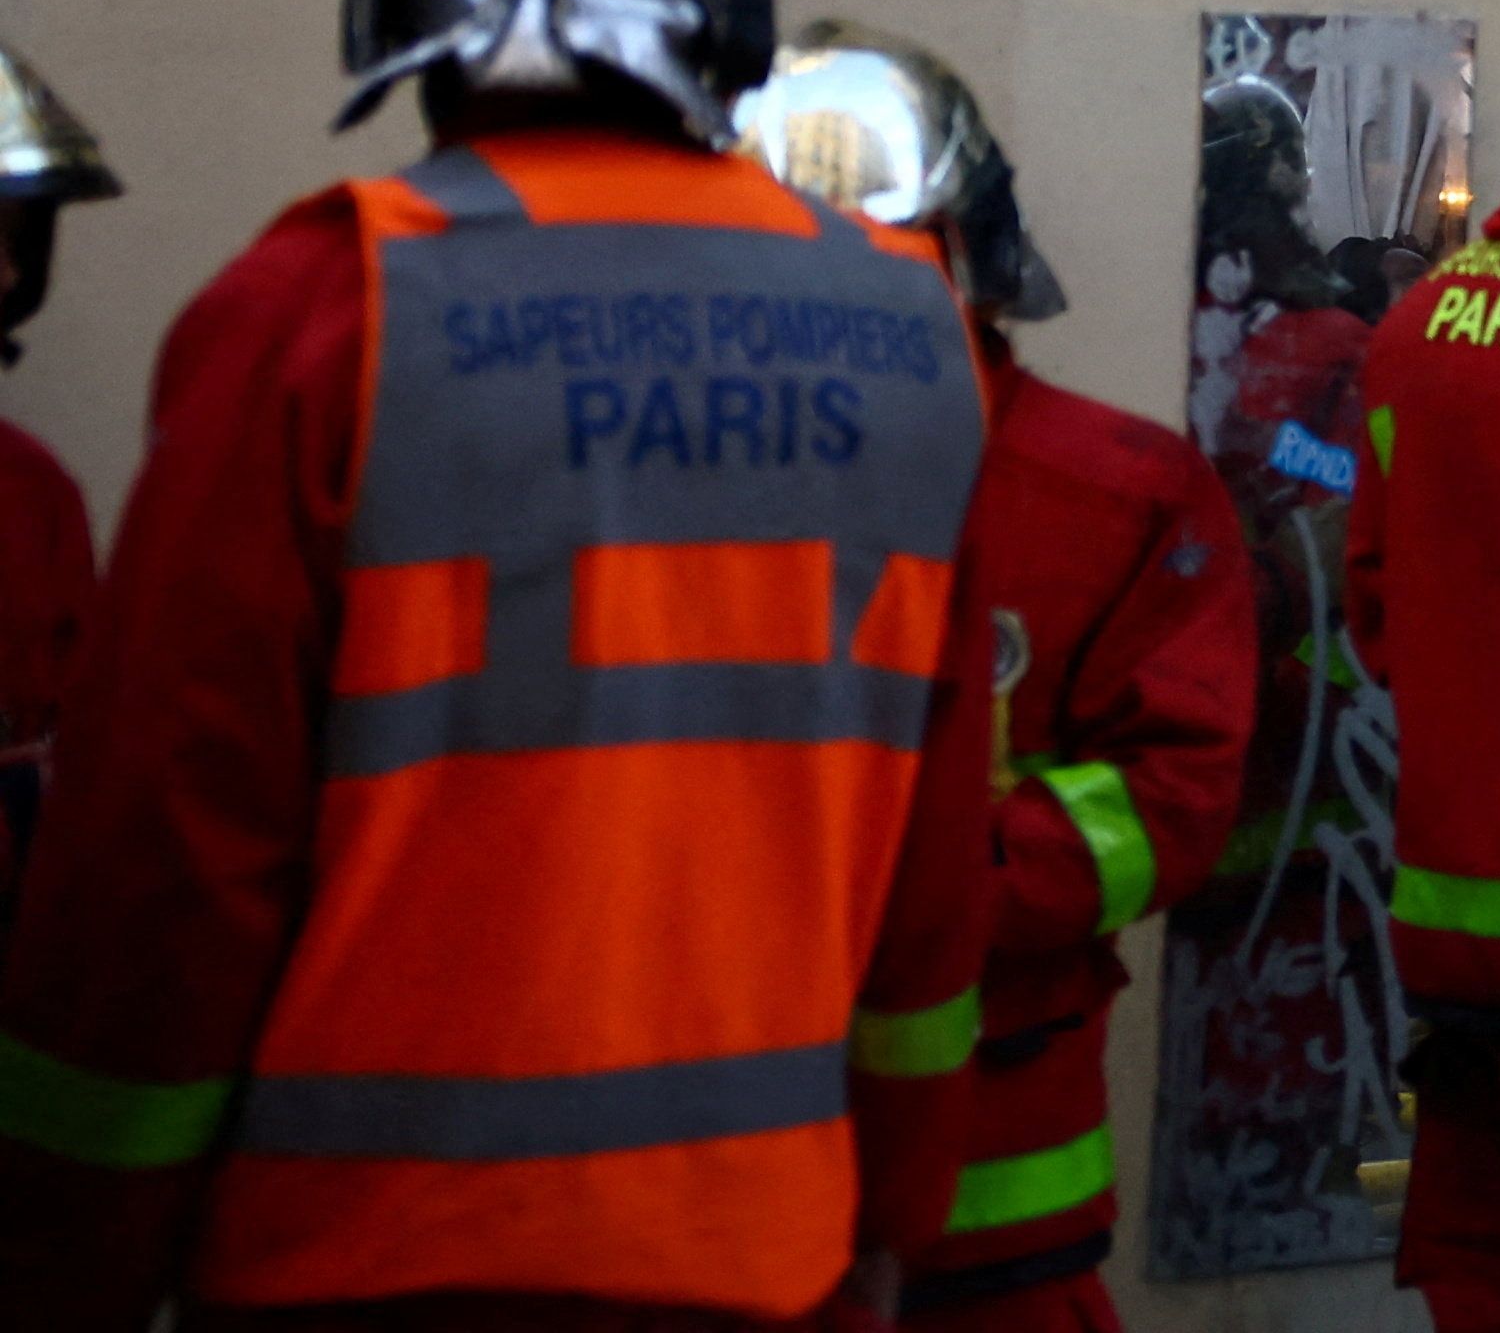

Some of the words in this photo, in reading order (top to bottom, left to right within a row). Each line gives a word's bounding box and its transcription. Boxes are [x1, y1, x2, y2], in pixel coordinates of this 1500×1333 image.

[443, 292, 697, 374] SAPEURS
[708, 293, 940, 385] POMPIERS
[563, 376, 865, 470] PARIS
